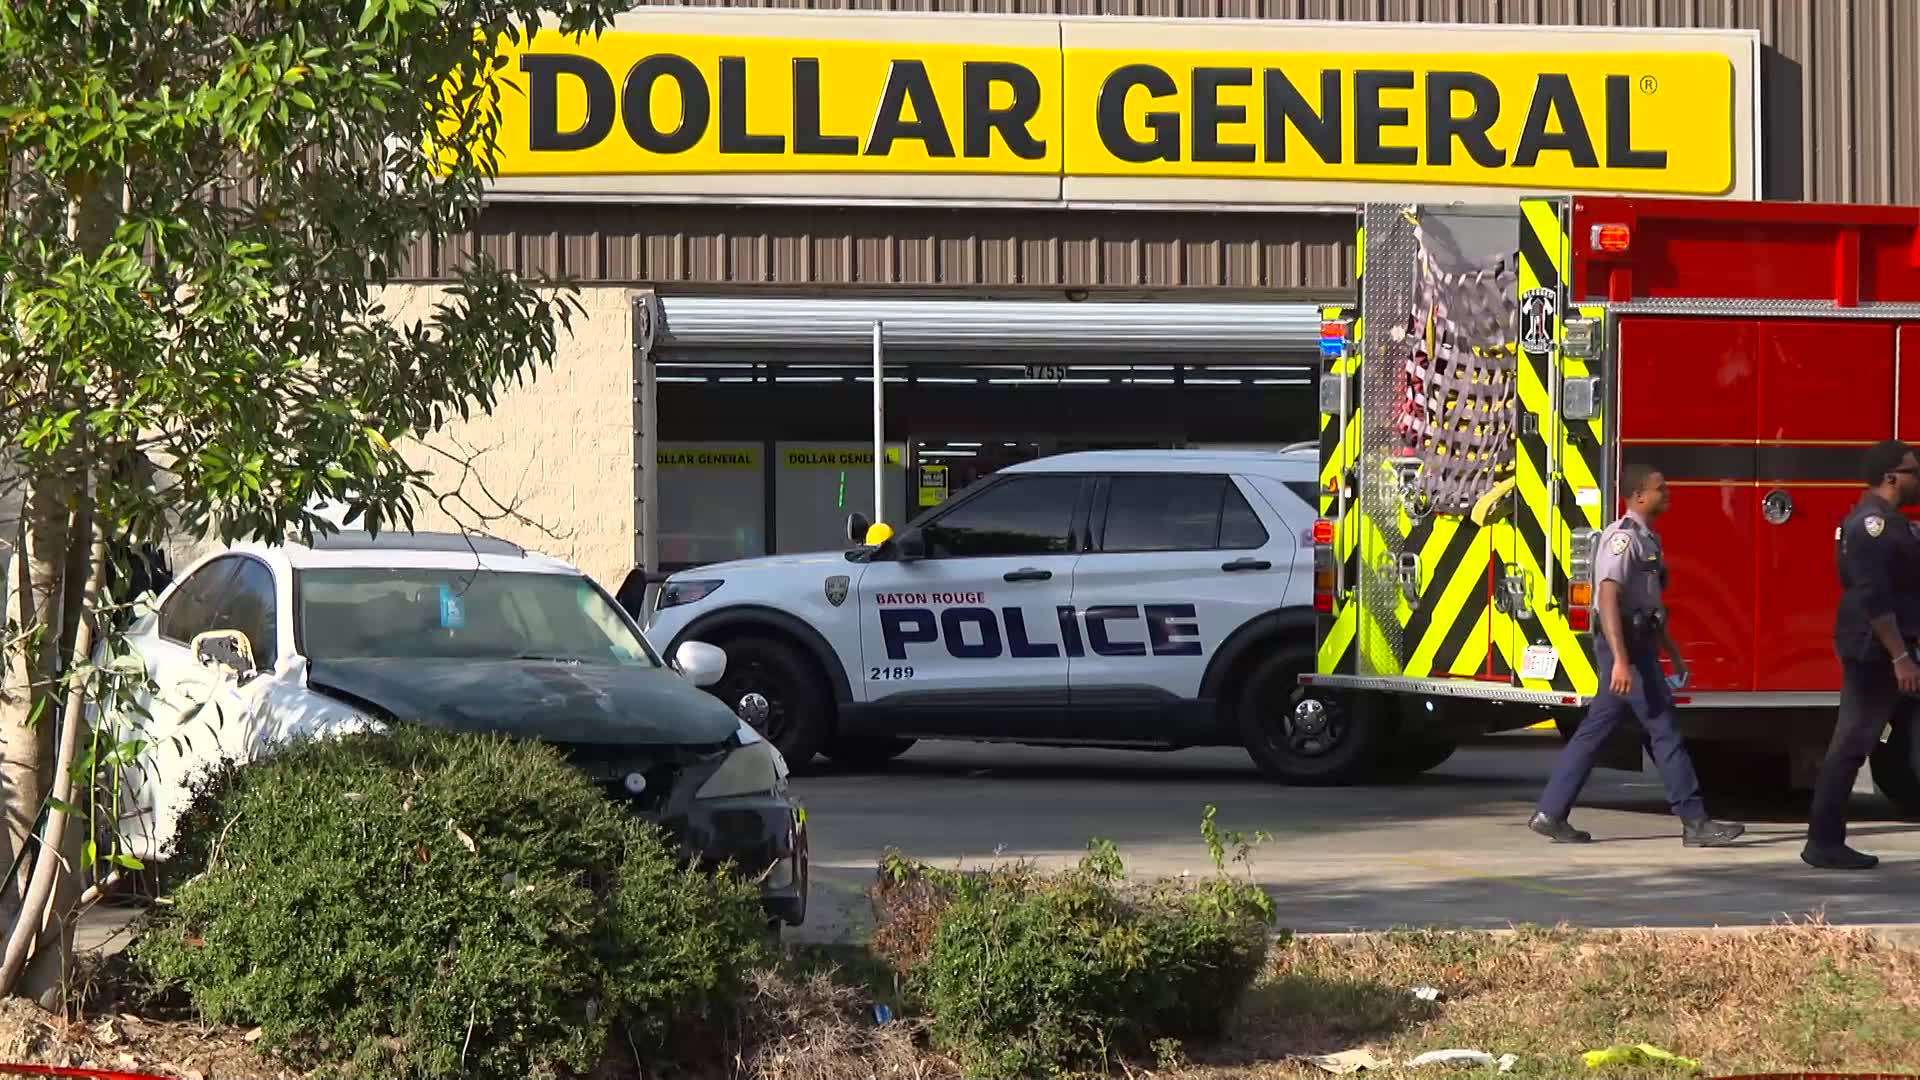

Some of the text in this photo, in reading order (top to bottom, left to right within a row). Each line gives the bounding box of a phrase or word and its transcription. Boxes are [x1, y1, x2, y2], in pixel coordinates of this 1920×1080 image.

[519, 52, 1047, 161] DOLLAR
[1095, 63, 1669, 171] GENERAL
[656, 454, 752, 465] OLLAR GENERAL
[788, 453, 836, 465] DOLLAR
[875, 591, 986, 605] BATON ROUGE
[879, 603, 1203, 660] POLICE
[870, 666, 915, 681] 2189
